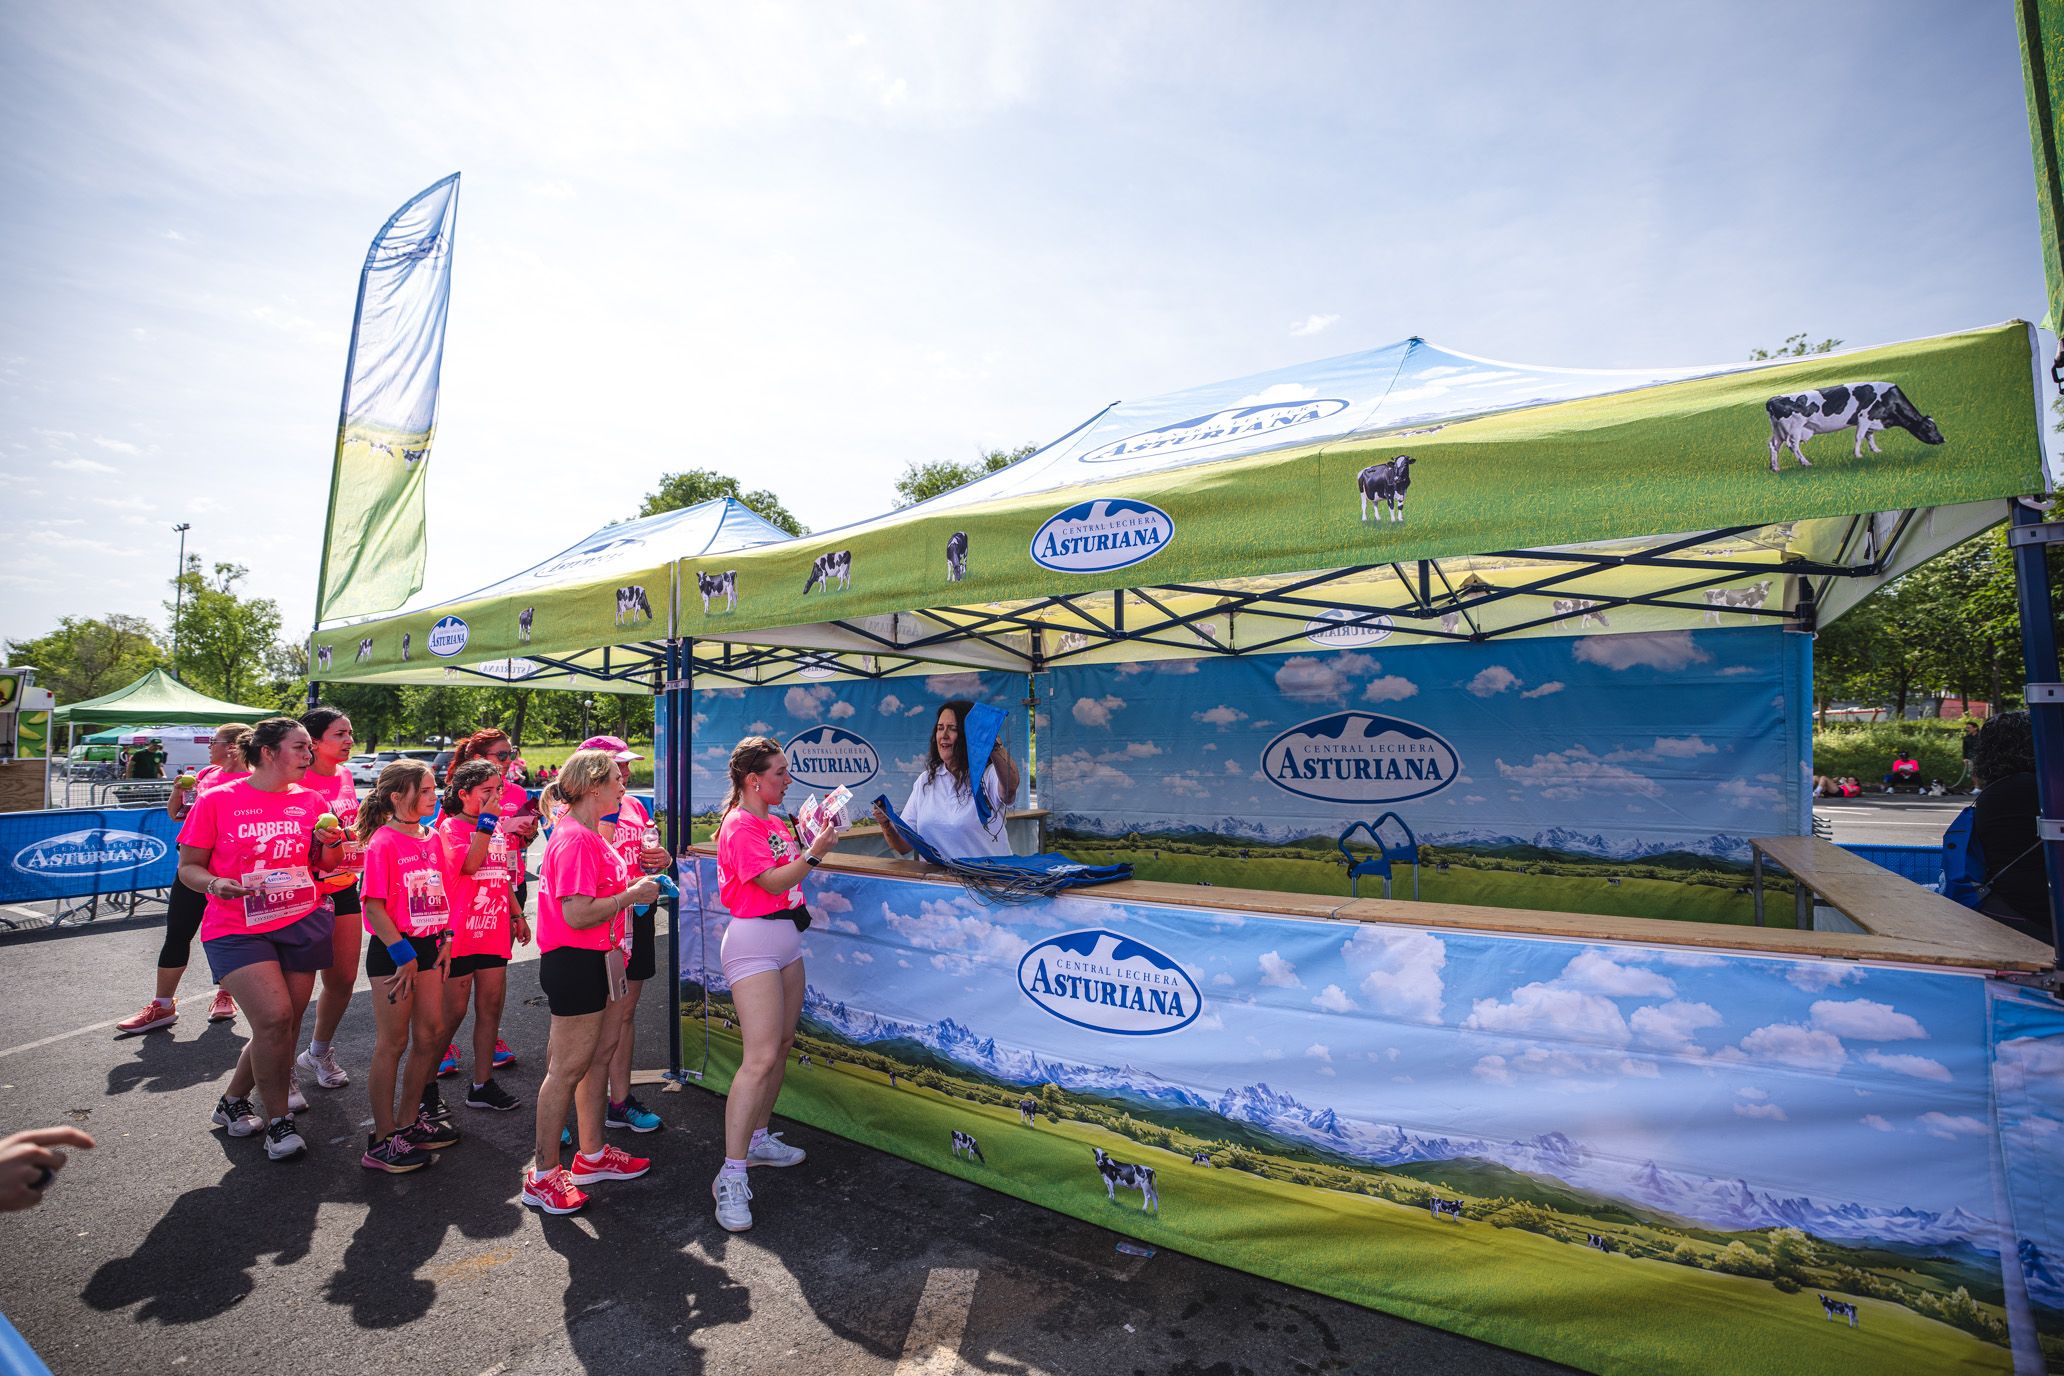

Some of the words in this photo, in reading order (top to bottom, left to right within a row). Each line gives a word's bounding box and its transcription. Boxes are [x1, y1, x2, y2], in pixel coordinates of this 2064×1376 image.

[1095, 410, 1322, 460] ASTURIANA
[1062, 523, 1106, 535] CENTRAL
[1109, 516, 1157, 529] LECHERA
[1040, 526, 1161, 558] ASTURIANA
[430, 633, 465, 647] ASTURIANA
[1303, 745, 1364, 753] CENTRAL
[1370, 744, 1435, 753] LECHERA
[790, 750, 872, 773] ASTURIANA
[1277, 747, 1443, 780] ASTURIANA
[233, 808, 263, 816] OYSHO
[238, 821, 302, 838] CARRERA
[26, 847, 156, 868] ASTURIANA
[272, 839, 293, 859] DE
[343, 852, 357, 861] 16
[490, 853, 506, 862] 016
[398, 855, 419, 865] OYSHO
[268, 890, 295, 902] 016
[466, 915, 498, 930] MUJER
[1056, 959, 1111, 976] CENTRAL
[1117, 968, 1179, 986] LECHERA
[1030, 958, 1186, 1018] ASTURIANA
